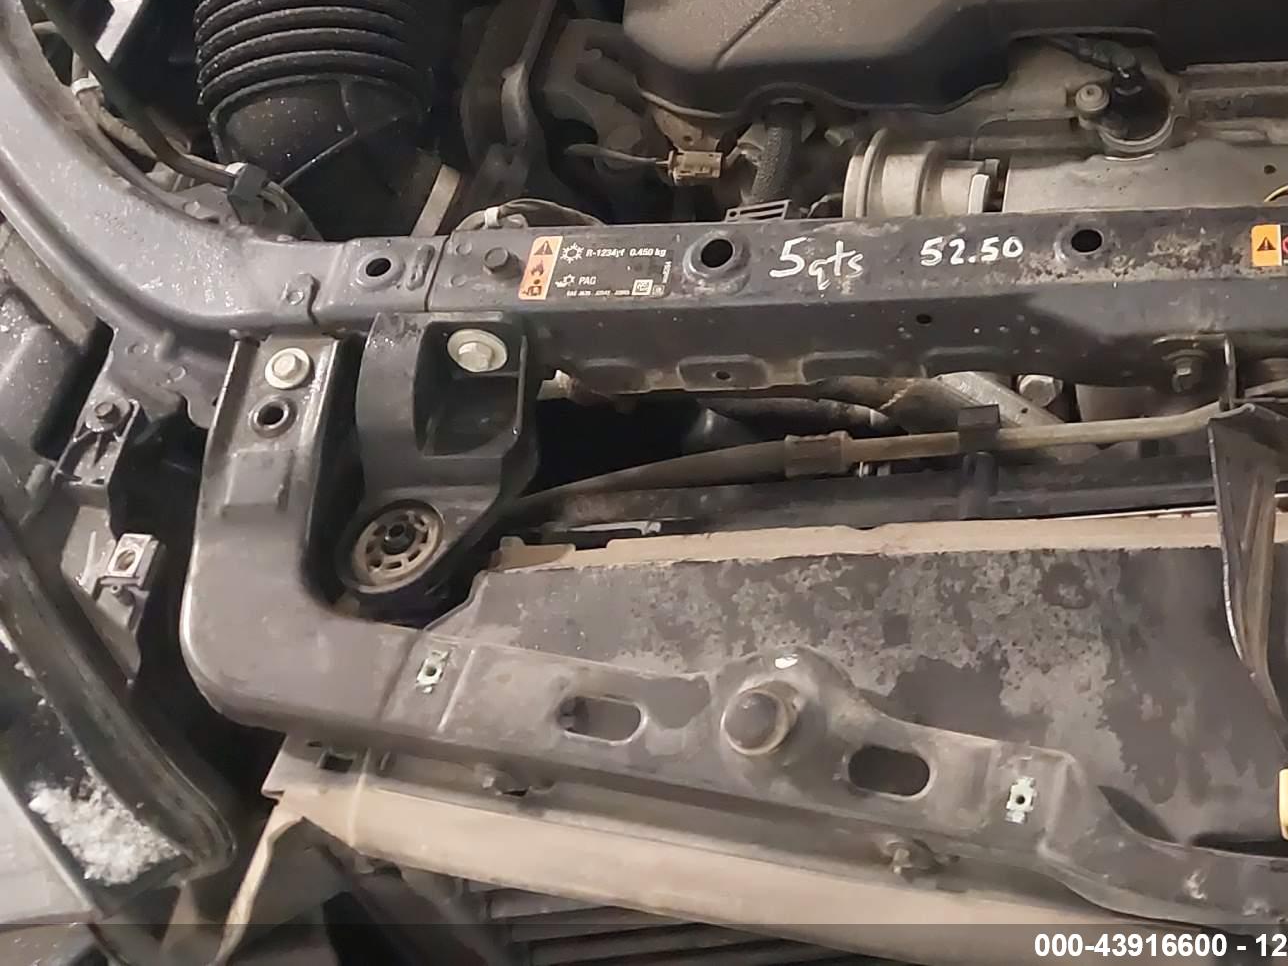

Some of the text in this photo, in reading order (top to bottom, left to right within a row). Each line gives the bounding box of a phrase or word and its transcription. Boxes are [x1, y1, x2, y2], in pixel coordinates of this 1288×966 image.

[585, 247, 625, 258] R-1234yf
[654, 247, 667, 258] kg
[919, 235, 1024, 266] 52.50
[578, 275, 597, 285] PAG
